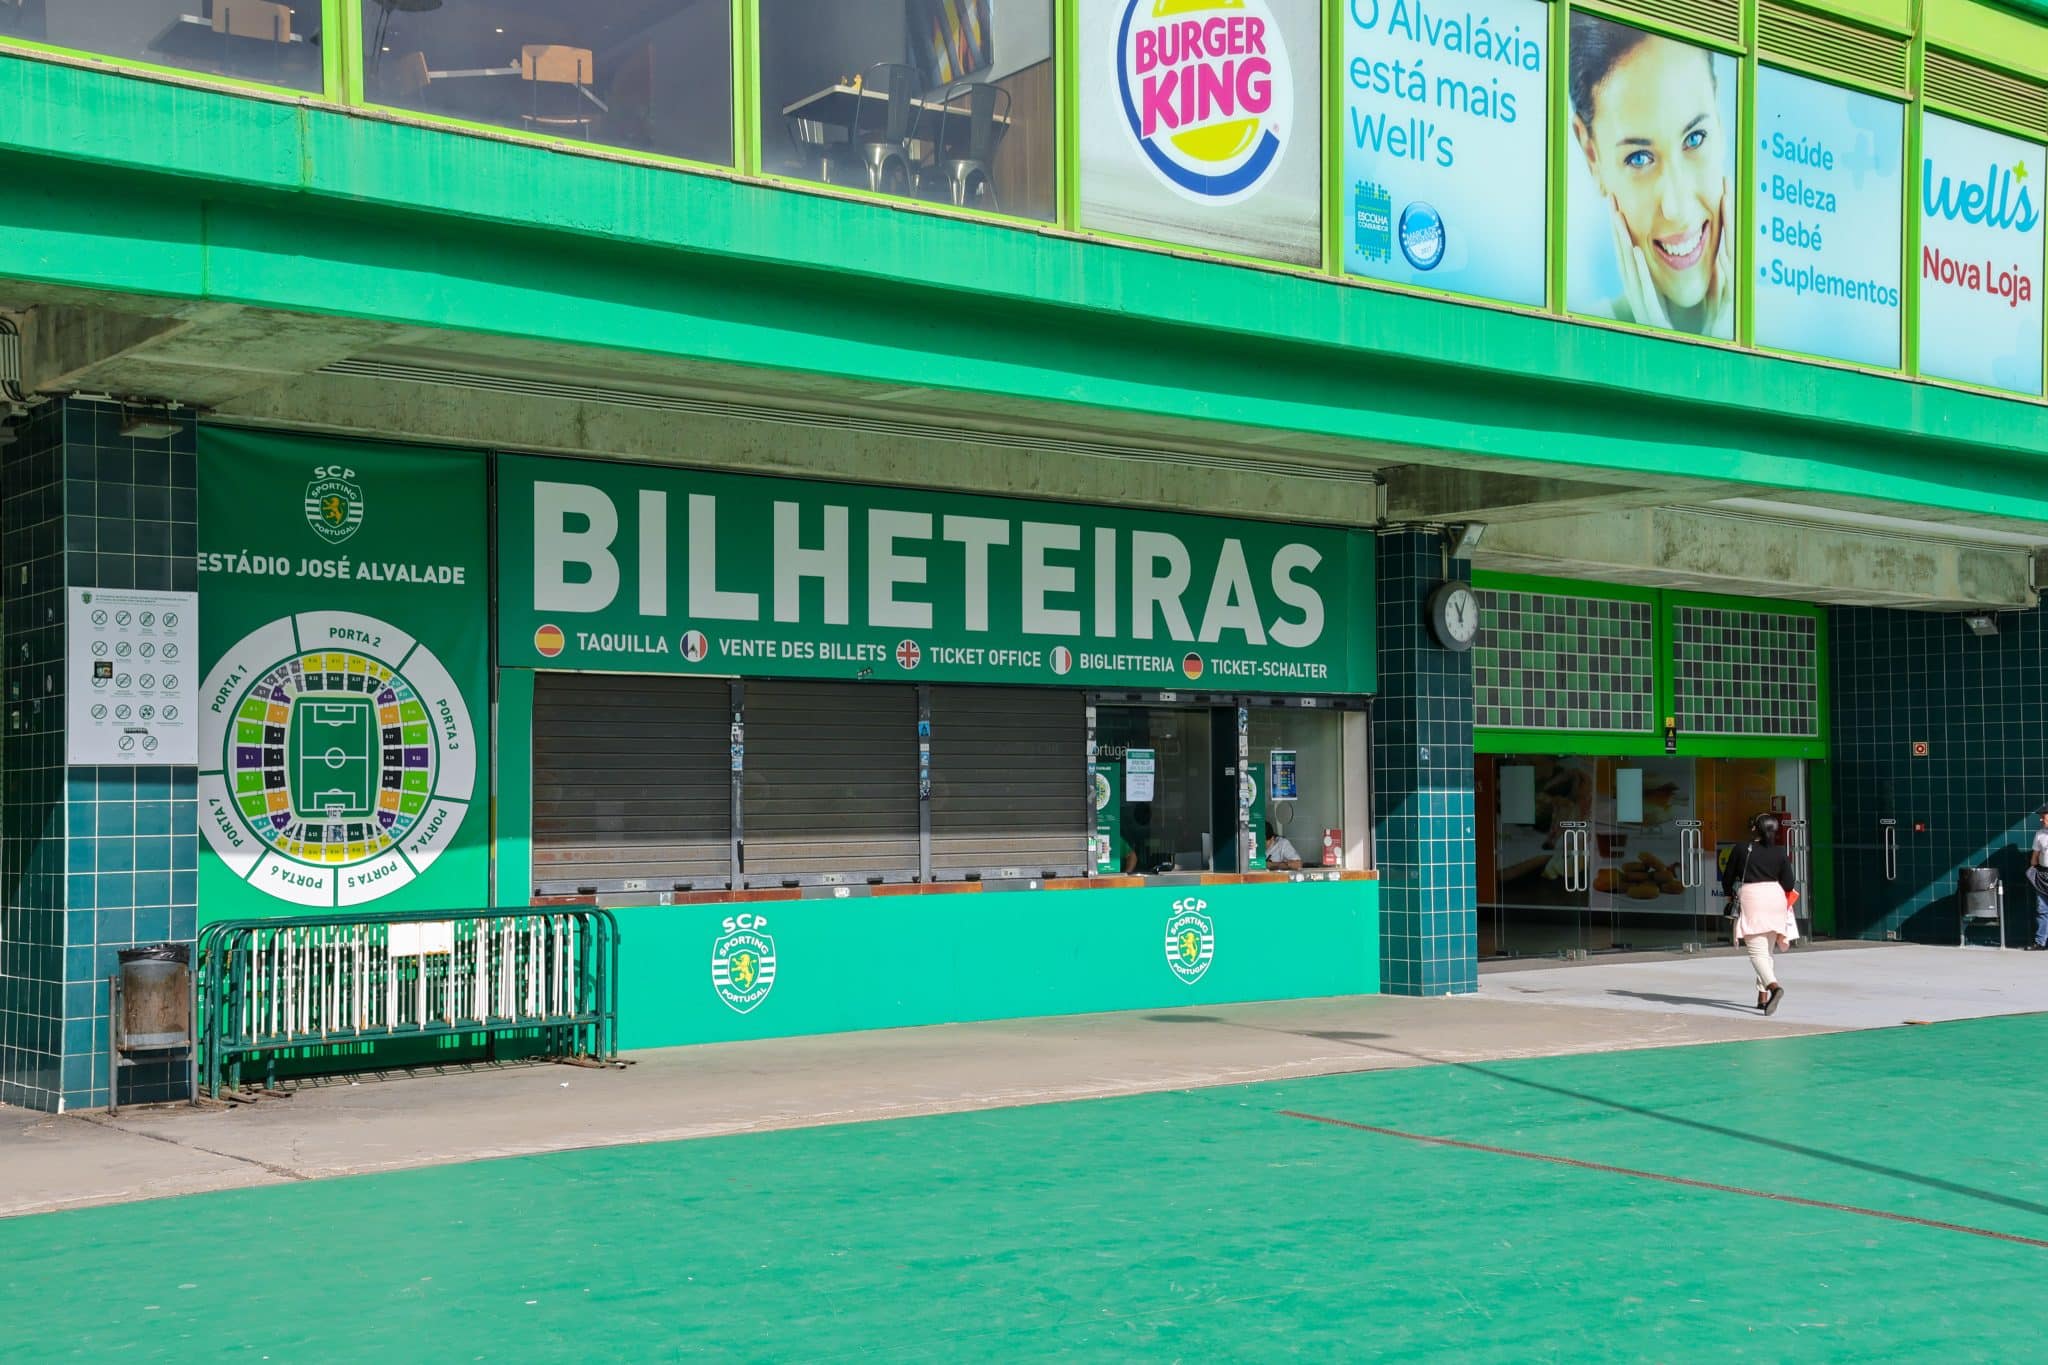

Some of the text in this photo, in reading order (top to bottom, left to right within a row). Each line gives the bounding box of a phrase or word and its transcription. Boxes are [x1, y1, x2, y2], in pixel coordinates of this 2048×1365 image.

[1135, 16, 1266, 76] BURGER
[1351, 0, 1540, 72] O Alvaláxia
[1141, 57, 1272, 139] KING
[1350, 56, 1517, 124] está mais
[1772, 132, 1834, 171] Saúde
[1772, 175, 1837, 214] Beleza
[1771, 217, 1822, 251] Bebé
[1771, 261, 1898, 307] Suplementos
[1923, 246, 2032, 308] Nova Loja
[314, 465, 356, 480] SCP
[311, 482, 357, 501] SPORTING
[314, 522, 356, 536] PORTUGAL
[197, 549, 465, 585] ESTÁDIO JOSÉ ALVALADE
[534, 480, 1325, 648] BILHETEIRAS
[329, 627, 381, 648] PORTA 2
[577, 632, 669, 653] TAQUILLA
[719, 638, 887, 662] VENTE DES BILLETS
[930, 647, 1041, 668] TICKET OFFICE
[1079, 652, 1175, 673] BIGLIETTERIA
[1211, 658, 1328, 680] TICKET-SCHALTER
[211, 664, 248, 713] PORTA 1
[436, 699, 459, 750] PORTA 3
[208, 798, 244, 847] PORTA 7
[410, 808, 447, 854] PORTA 4
[271, 865, 323, 889] PORTA 6
[347, 861, 398, 888] PORTA 5
[1172, 897, 1208, 914] SCP
[722, 913, 768, 933] SCP
[1171, 916, 1208, 935] SPORTING
[719, 935, 769, 957] SPORTING
[1173, 961, 1208, 975] PORTUGAL
[722, 987, 768, 1003] PORTUGAL
